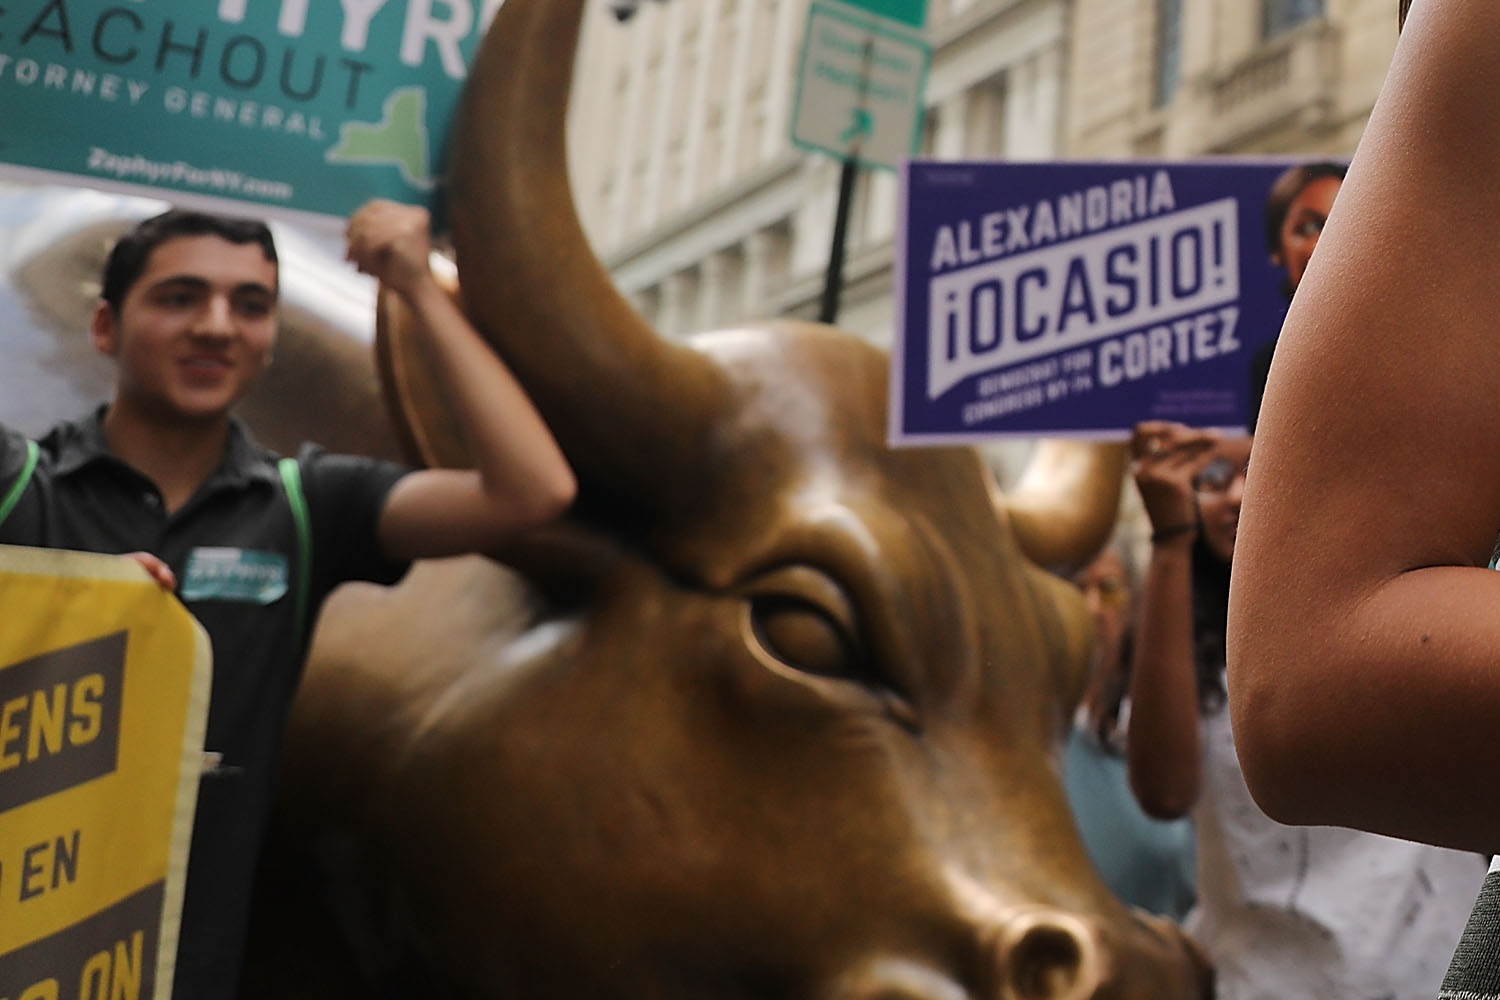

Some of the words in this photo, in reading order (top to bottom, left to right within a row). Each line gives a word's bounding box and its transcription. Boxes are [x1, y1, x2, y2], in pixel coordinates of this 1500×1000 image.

[164, 86, 326, 141] GENERAL
[931, 171, 1175, 271] ALEXANDRIA
[1100, 307, 1242, 388] CORTEZ
[0, 671, 104, 774] ENS
[19, 829, 81, 903] EN
